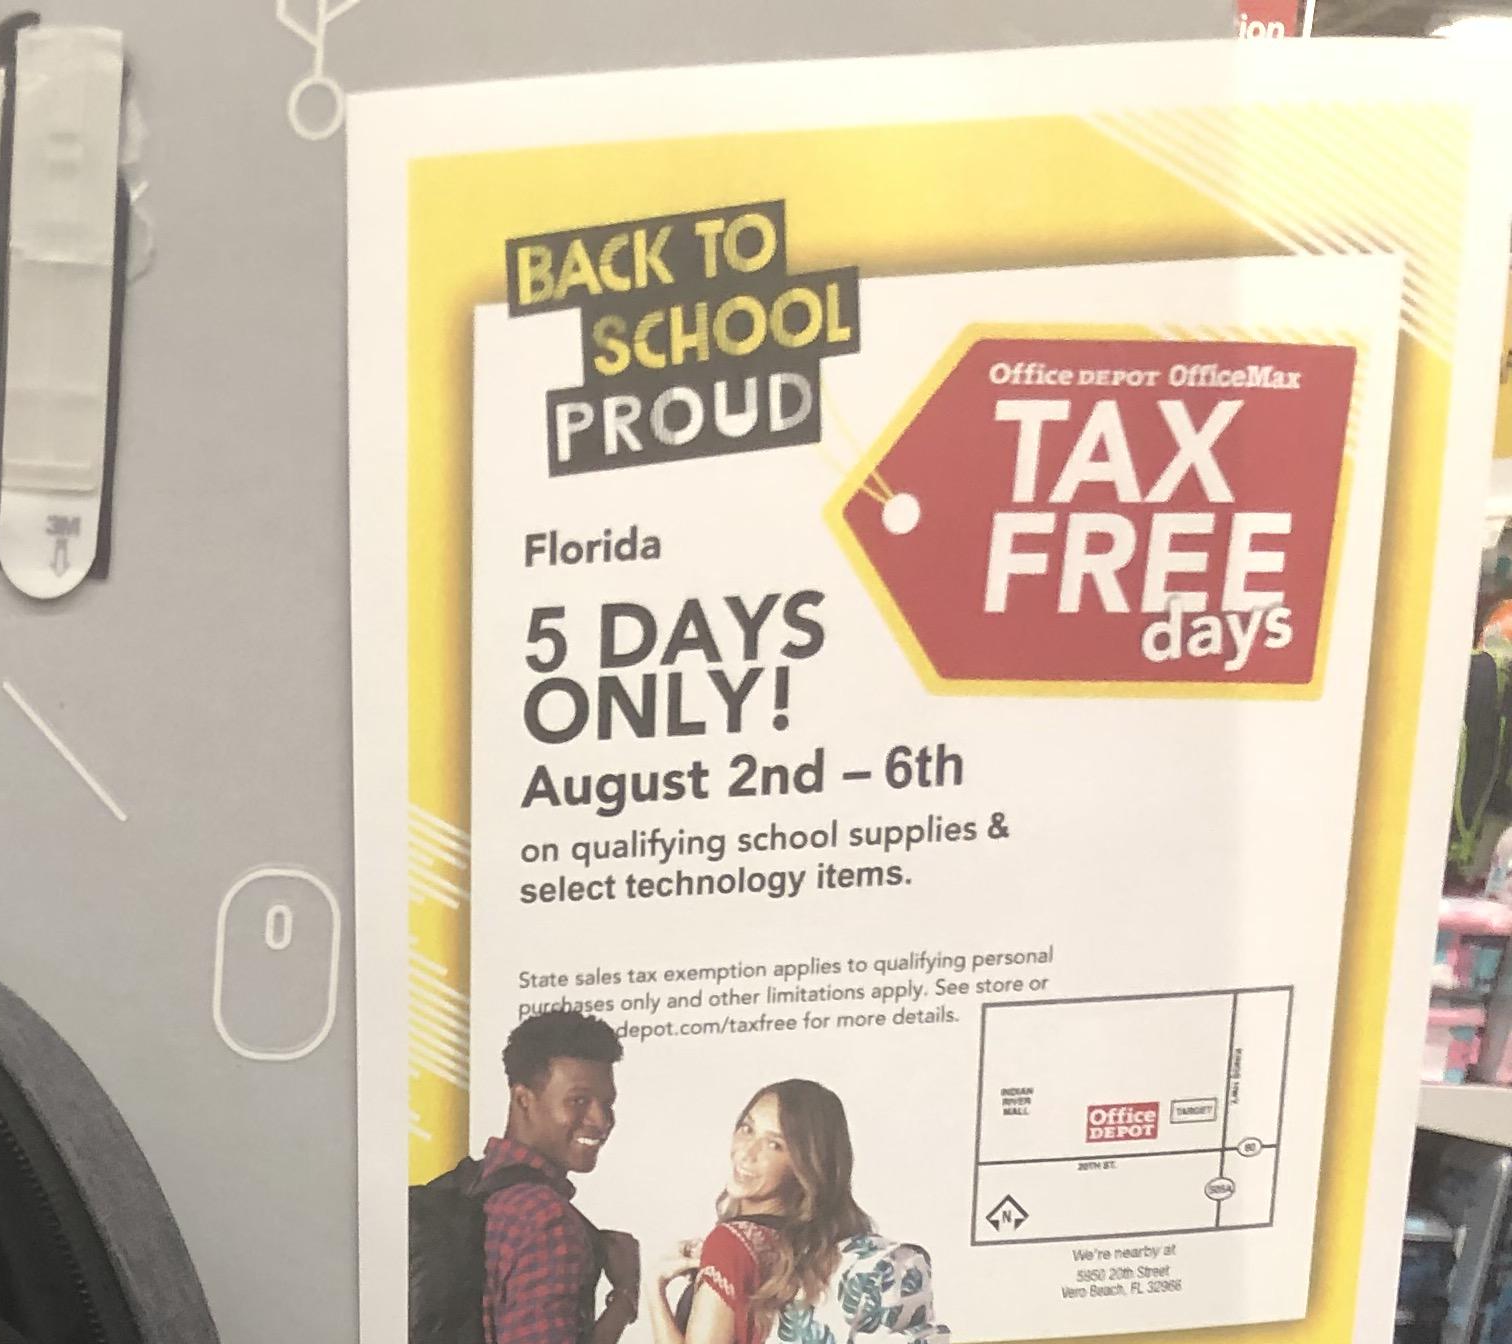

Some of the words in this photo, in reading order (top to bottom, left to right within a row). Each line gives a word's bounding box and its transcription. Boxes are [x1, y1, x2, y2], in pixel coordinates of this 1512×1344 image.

[1240, 14, 1285, 38] ion
[517, 225, 676, 306] BACK
[695, 213, 778, 279] TO
[593, 282, 851, 377] SCHOOL
[988, 362, 1074, 387] Office
[1076, 368, 1160, 387] DEPOT
[1168, 363, 1302, 389] OfficeMax
[555, 372, 813, 463] PROUD
[994, 399, 1245, 503] TAX
[45, 514, 81, 536] 3M
[524, 525, 662, 567] Florida
[984, 511, 1292, 615] FREE
[524, 606, 567, 673] 5
[599, 589, 826, 669] DAYS
[1141, 594, 1293, 671] days
[523, 666, 791, 745] ONLY!
[520, 760, 710, 818] August
[728, 747, 826, 797] 2nd
[885, 743, 964, 790] 6th
[520, 840, 559, 864] on
[571, 829, 727, 867] qualifying
[737, 820, 838, 853] school
[848, 815, 978, 851] supplies
[987, 811, 1011, 839] &
[519, 872, 616, 903] select
[626, 866, 806, 898] technology
[816, 861, 912, 890] items.
[519, 971, 569, 989] State
[575, 967, 622, 986] sales
[628, 969, 658, 983] tax
[664, 961, 767, 985] exemption
[773, 956, 841, 981] applies
[848, 957, 868, 973] to
[873, 950, 966, 975] qualifying
[972, 944, 1054, 972] personal
[519, 996, 614, 1021] purchases
[620, 992, 661, 1014] only
[666, 989, 703, 1009] and
[708, 987, 760, 1007] other
[766, 983, 865, 1005] limitations
[871, 979, 928, 1005] apply.
[935, 977, 969, 996] See
[975, 978, 1024, 994] store
[1029, 976, 1050, 991] or
[616, 1014, 797, 1042] depot.com/taxfree
[803, 1011, 830, 1030] for
[836, 1010, 886, 1028] more
[892, 1006, 960, 1026] details.
[1088, 1105, 1157, 1126] Office
[1089, 1124, 1156, 1140] DEPOT
[1002, 1210, 1012, 1223] N
[1072, 1248, 1111, 1261] We're
[1114, 1246, 1159, 1259] nearby
[1163, 1244, 1176, 1256] at
[1137, 1265, 1170, 1278] Street
[1130, 1282, 1143, 1294] FL
